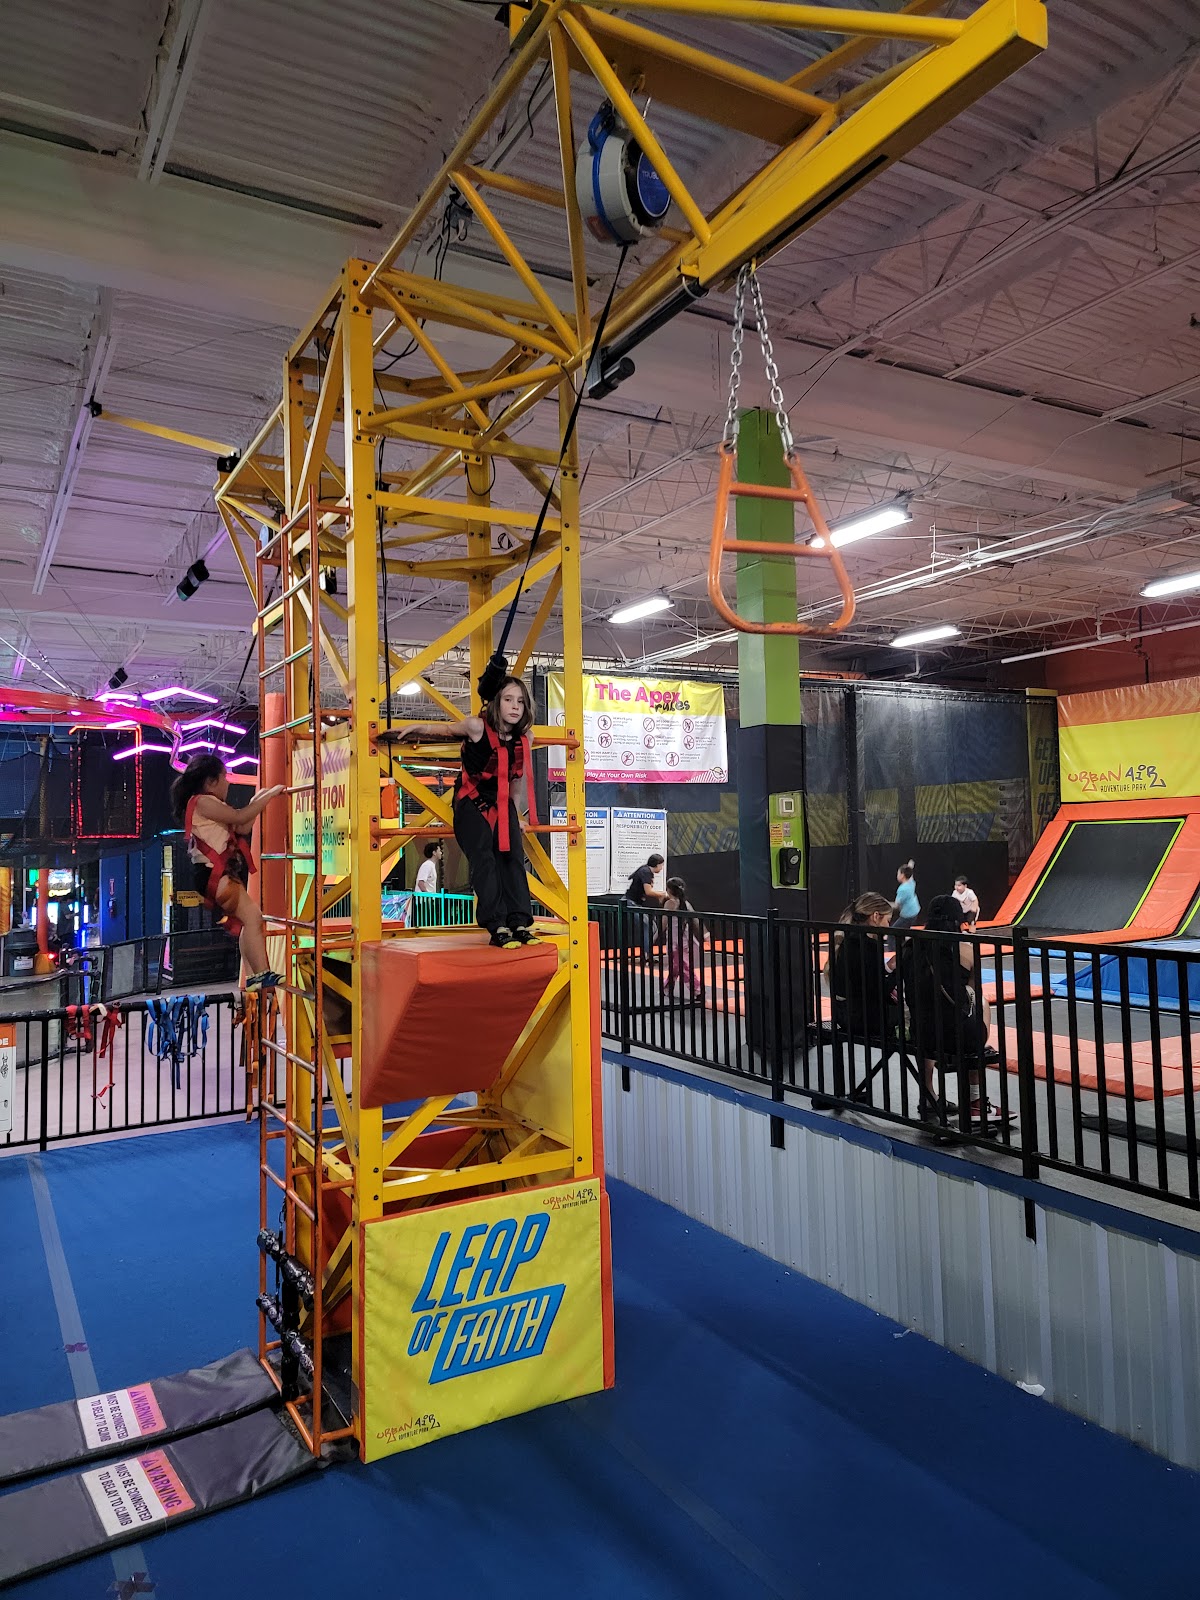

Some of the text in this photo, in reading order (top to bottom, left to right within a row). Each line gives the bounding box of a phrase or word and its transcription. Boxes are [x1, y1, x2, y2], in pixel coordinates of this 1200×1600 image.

[594, 682, 681, 708] The Apex
[586, 771, 599, 779] Play
[1067, 763, 1122, 792] URBAN
[1100, 783, 1147, 793] ADVENTURE PARK
[295, 784, 345, 813] ATTETION
[623, 811, 656, 819] ATTENTION
[543, 1189, 575, 1210] URBAN
[410, 1212, 551, 1313] LEAP
[407, 1311, 448, 1357] OF
[441, 1294, 551, 1371] FAITH
[91, 1399, 111, 1442] TO BELAY TO CLIMB
[106, 1393, 129, 1440] MUST BE CONNECTED
[132, 1395, 157, 1430] WARNING
[377, 1417, 413, 1444] URBAN
[98, 1471, 133, 1527] TO BELAY TO CLIMB
[114, 1463, 153, 1522] MUST BE CONNECTED
[147, 1464, 183, 1509] WARNING
